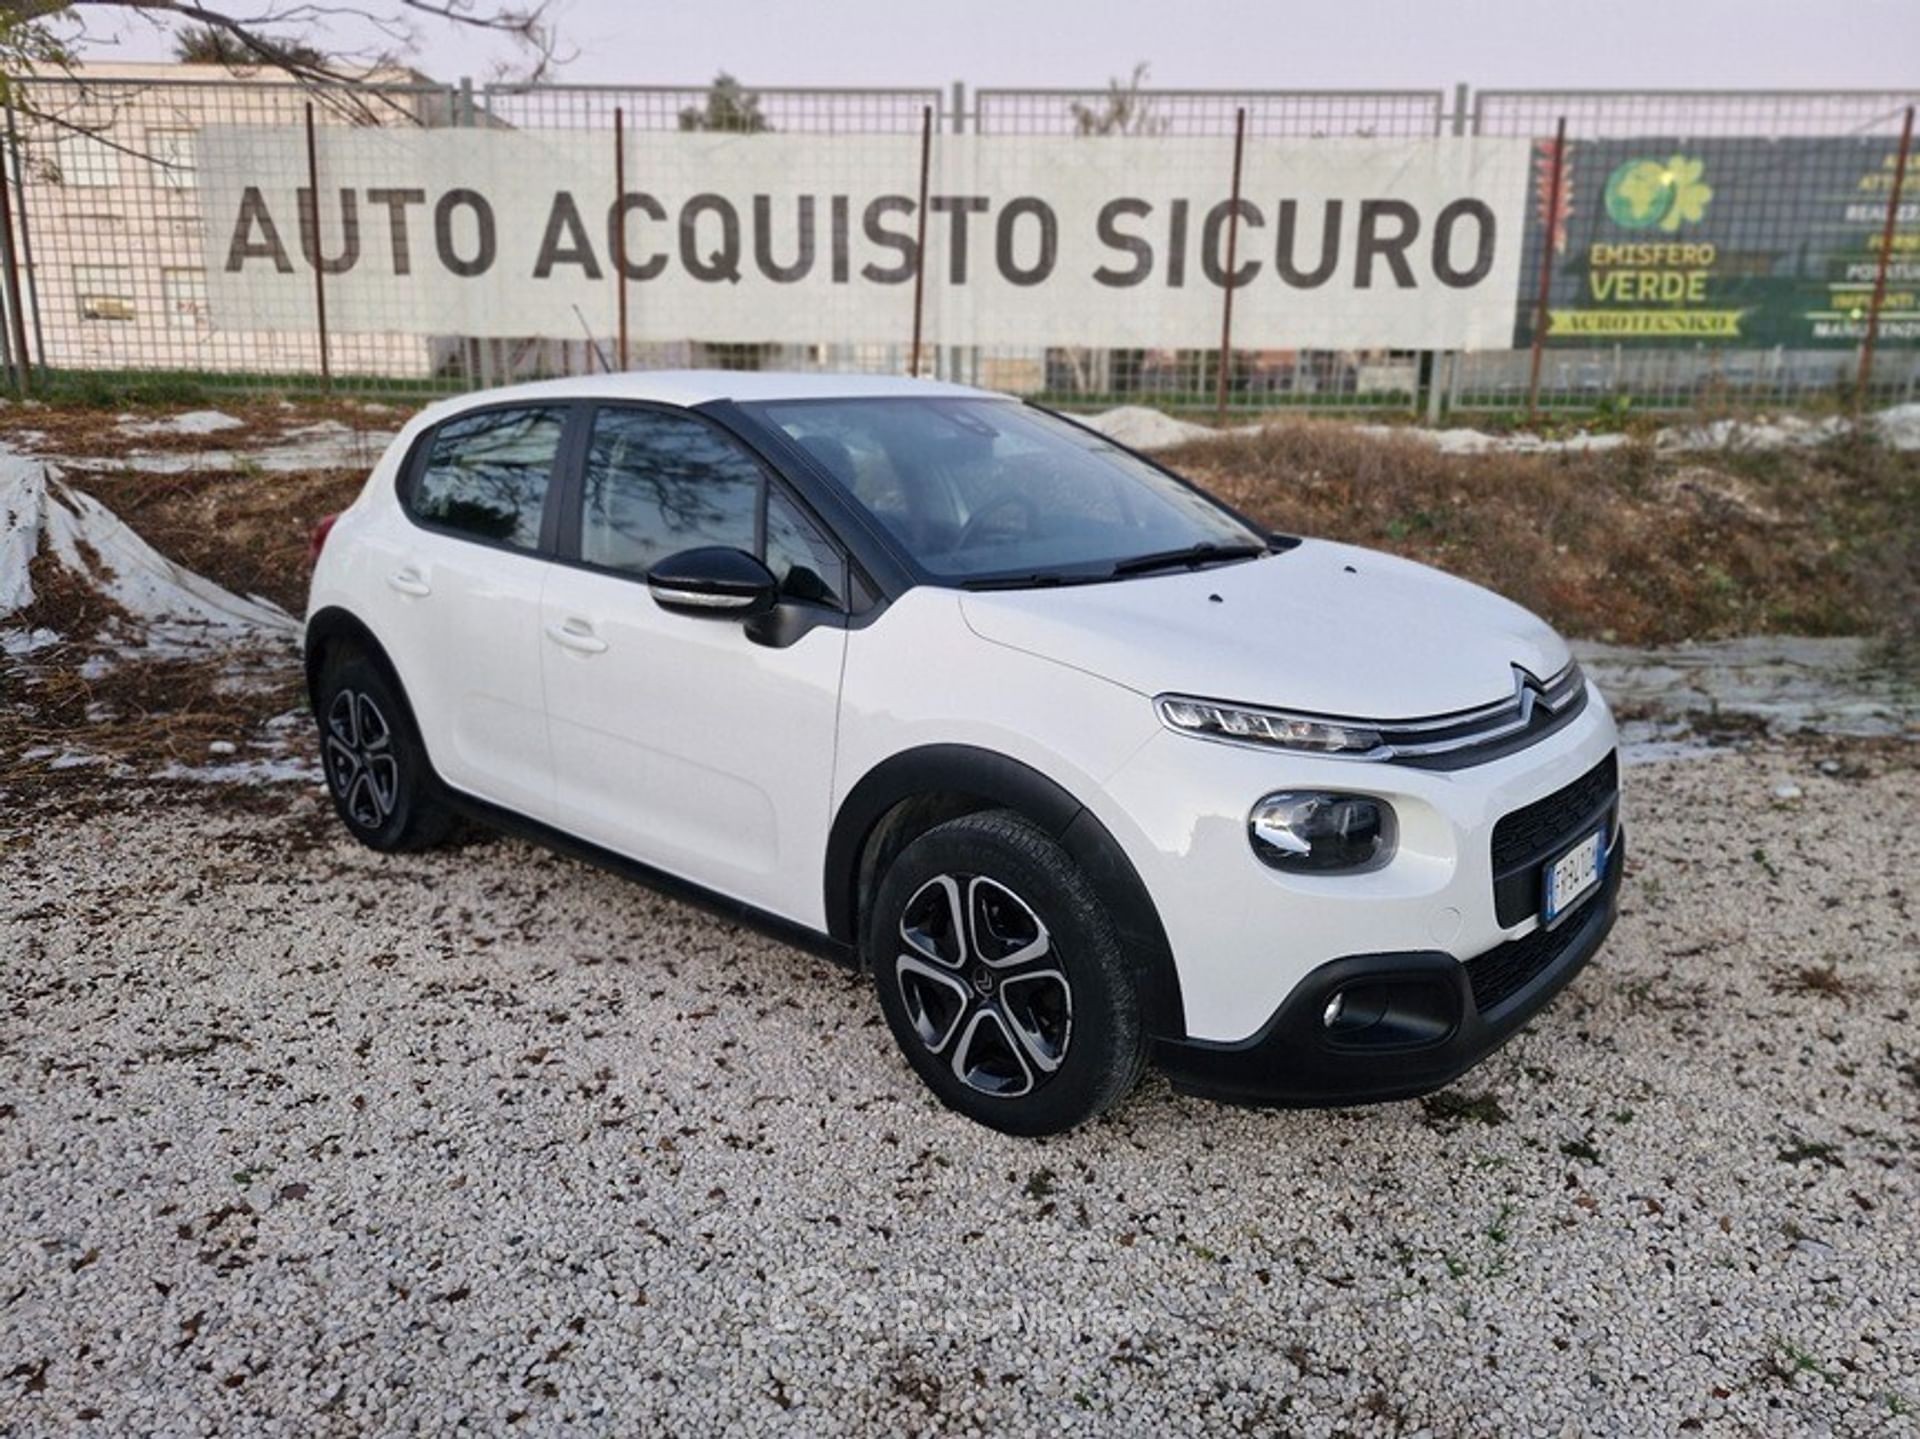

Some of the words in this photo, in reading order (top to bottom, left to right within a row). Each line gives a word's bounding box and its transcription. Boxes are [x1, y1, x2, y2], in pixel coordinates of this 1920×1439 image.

[224, 186, 497, 277] AUTO
[532, 190, 1059, 286] ACQUISTO
[1091, 197, 1497, 289] SICURO
[1590, 242, 1716, 266] EMISFERO
[1590, 269, 1708, 302] VERDE
